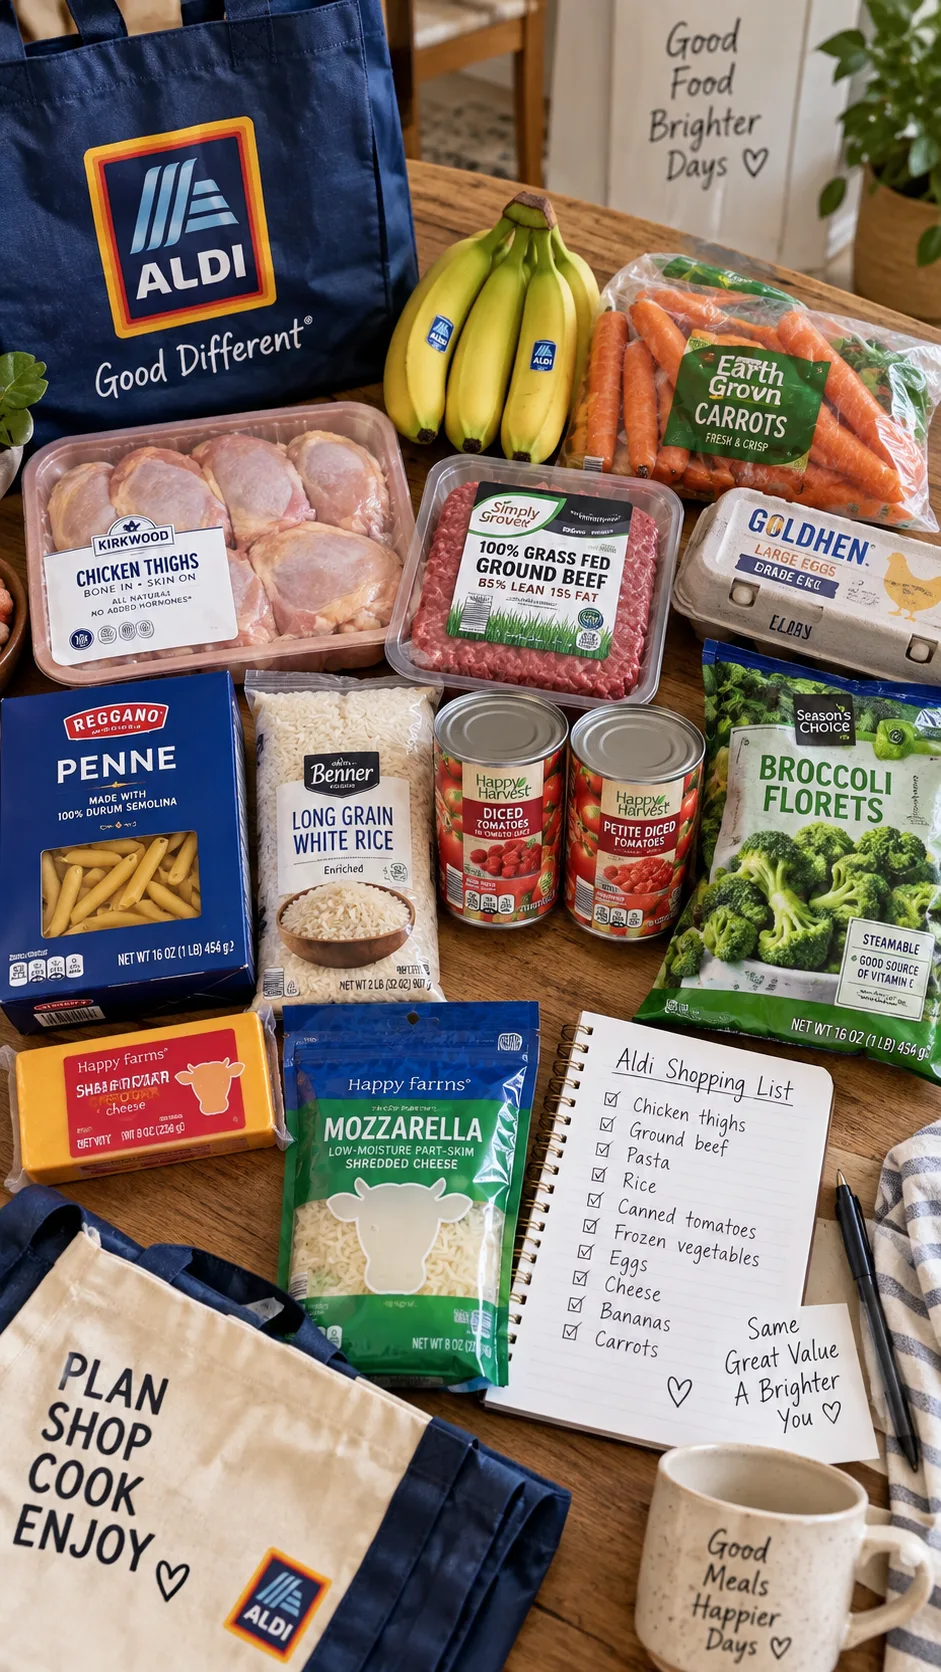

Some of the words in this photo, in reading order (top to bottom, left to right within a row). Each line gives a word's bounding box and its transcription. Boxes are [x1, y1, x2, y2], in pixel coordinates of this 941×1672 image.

[666, 18, 741, 60] Good
[671, 62, 735, 100] Food
[649, 105, 762, 150] Brighter
[666, 150, 728, 190] Days
[136, 244, 247, 300] ALDI
[95, 348, 167, 399] Good
[533, 357, 552, 365] ALDI
[716, 355, 785, 387] Earth
[695, 402, 788, 438] CARROTS
[743, 439, 769, 452] CRISP
[491, 500, 540, 521] Simply
[98, 530, 169, 551] KIRKWOOD
[479, 540, 519, 557] 100%
[524, 546, 576, 565] GRASS
[580, 554, 611, 571] FED
[754, 543, 798, 567] LARGE
[801, 555, 836, 577] EGGS
[76, 560, 140, 588] CHICKEN
[143, 553, 200, 576] THIGHS
[476, 558, 557, 582] GROUND
[562, 569, 608, 590] BEEF
[84, 583, 116, 598] BONE
[121, 582, 133, 591] IN
[147, 575, 175, 588] SKIN
[179, 573, 196, 583] ON
[511, 582, 545, 595] LEAN
[576, 591, 599, 603] FAT
[112, 597, 127, 605] ALL
[73, 708, 159, 732] REGGANO
[57, 746, 176, 784] PENNE
[310, 763, 374, 785] Benner
[759, 754, 892, 796] BROCCOLI
[476, 774, 521, 792] Happy
[478, 785, 532, 800] Harvest
[58, 808, 83, 821] 100%
[87, 804, 123, 817] DURUM
[126, 797, 177, 811] SEMOLINA
[89, 794, 118, 805] MADE
[121, 790, 146, 801] WITH
[616, 791, 659, 809] Happy
[618, 801, 670, 817] Harvest
[763, 785, 884, 824] FLORETS
[292, 807, 336, 831] LONG
[341, 805, 394, 826] GRAIN
[476, 818, 529, 830] TOMATOES
[484, 807, 523, 820] DICED
[293, 831, 348, 855] WHITE
[355, 829, 394, 851] RICE
[604, 820, 642, 838] PETITE
[644, 820, 676, 838] DICED
[614, 836, 665, 848] TOMATOES
[324, 863, 364, 875] Enriched
[118, 952, 135, 966] NET
[136, 950, 150, 963] WT
[152, 949, 163, 961] 16
[164, 946, 176, 959] OZ
[178, 945, 186, 959] (1
[188, 943, 202, 957] LB)
[863, 934, 920, 955] STEAMABLE
[858, 970, 868, 979] OF
[871, 974, 906, 987] VITAMIN
[860, 955, 883, 969] GOOD
[886, 962, 919, 976] SOURCE
[340, 980, 354, 991] NET
[355, 980, 367, 991] WT
[368, 979, 373, 990] 2
[791, 1018, 813, 1033] NET
[814, 1023, 833, 1037] WT
[834, 1026, 847, 1040] 16
[849, 1030, 865, 1045] OZ
[865, 1033, 876, 1048] (1
[877, 1036, 896, 1053] LB)
[77, 1058, 120, 1074] Happy
[615, 1047, 655, 1074] Aldi
[665, 1058, 746, 1103] Shopping
[757, 1075, 794, 1101] List
[348, 1079, 404, 1094] Happy
[106, 1101, 146, 1116] cheese
[633, 1096, 689, 1122] Chicken
[699, 1109, 746, 1137] thighs
[324, 1116, 483, 1142] MOZZARELLA
[629, 1121, 684, 1147] Ground
[695, 1134, 730, 1157] beef
[328, 1145, 412, 1157] LOW-MOISTURE
[415, 1145, 474, 1157] PART-SKIM
[345, 1158, 409, 1169] SHREDDED
[413, 1159, 458, 1170] CHEESE
[627, 1146, 670, 1171] Pasta
[622, 1172, 657, 1194] Rice
[618, 1198, 677, 1225] Canned
[685, 1211, 756, 1240] tomatoes
[614, 1224, 666, 1249] Frozen
[678, 1240, 760, 1268] vegetables
[609, 1250, 648, 1278] Eggs
[604, 1275, 661, 1303] Cheese
[600, 1302, 671, 1332] Bananas
[747, 1316, 799, 1340] Same
[412, 1337, 428, 1349] NET
[430, 1338, 443, 1350] WT
[445, 1338, 450, 1350] 8
[452, 1338, 463, 1351] OZ
[595, 1330, 658, 1358] Carrots
[725, 1349, 779, 1376] Great
[788, 1338, 839, 1366] Value
[58, 1351, 169, 1415] PLAN
[735, 1381, 749, 1406] A
[760, 1371, 840, 1408] Brighter
[41, 1402, 152, 1461] SHOP
[777, 1408, 813, 1434] You
[28, 1452, 144, 1516] COOK
[13, 1503, 156, 1572] ENJOY
[707, 1528, 772, 1563] Good
[703, 1563, 769, 1597] Meals
[243, 1604, 293, 1642] ALDI
[692, 1593, 781, 1633] Happier
[705, 1628, 758, 1664] Days
